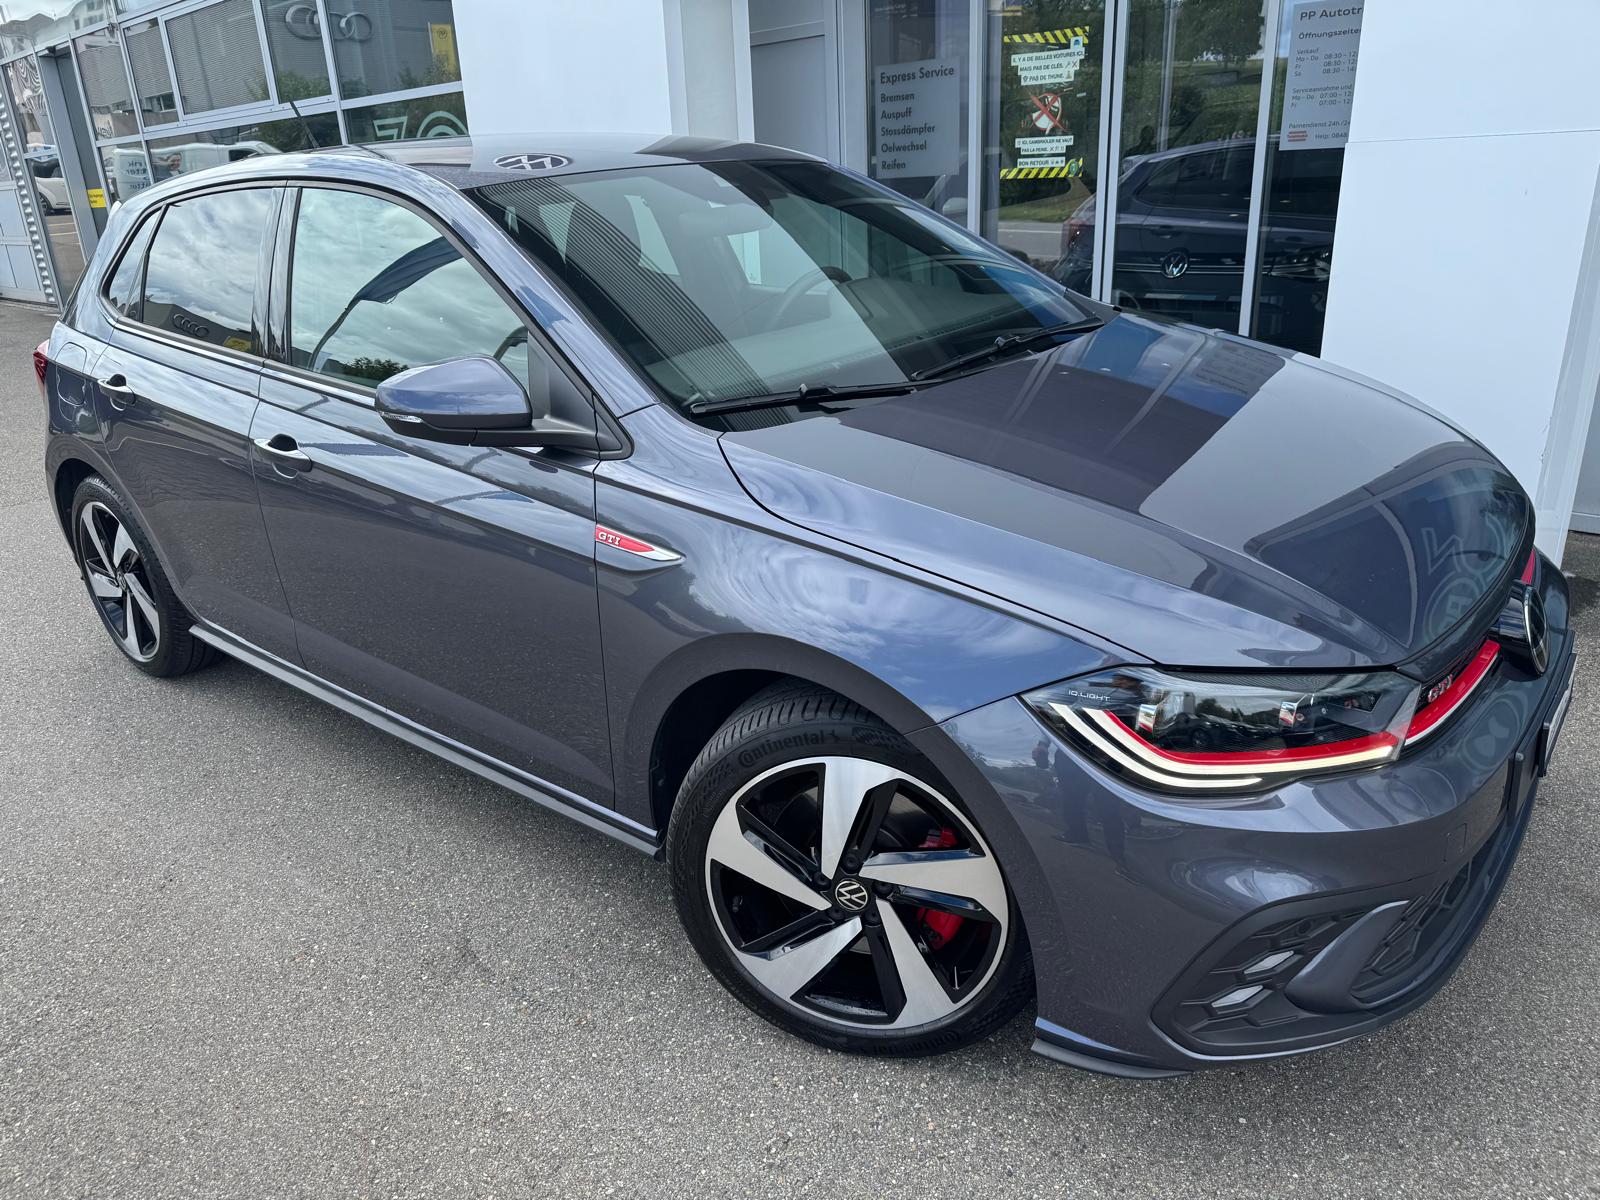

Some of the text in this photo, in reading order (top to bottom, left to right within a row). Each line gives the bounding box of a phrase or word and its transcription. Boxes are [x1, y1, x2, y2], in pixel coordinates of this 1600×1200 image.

[1300, 6, 1362, 21] PP Autotr
[880, 65, 954, 85] Express Service
[880, 93, 915, 103] Bremsen
[881, 107, 912, 120] Auspuff
[881, 122, 935, 136] Stossdämpfer
[881, 140, 927, 153] Oelwechsel
[881, 159, 906, 170] Reifen
[598, 532, 621, 545] GTI
[1068, 689, 1110, 702] IQ.LIGHT
[738, 730, 825, 767] Continental
